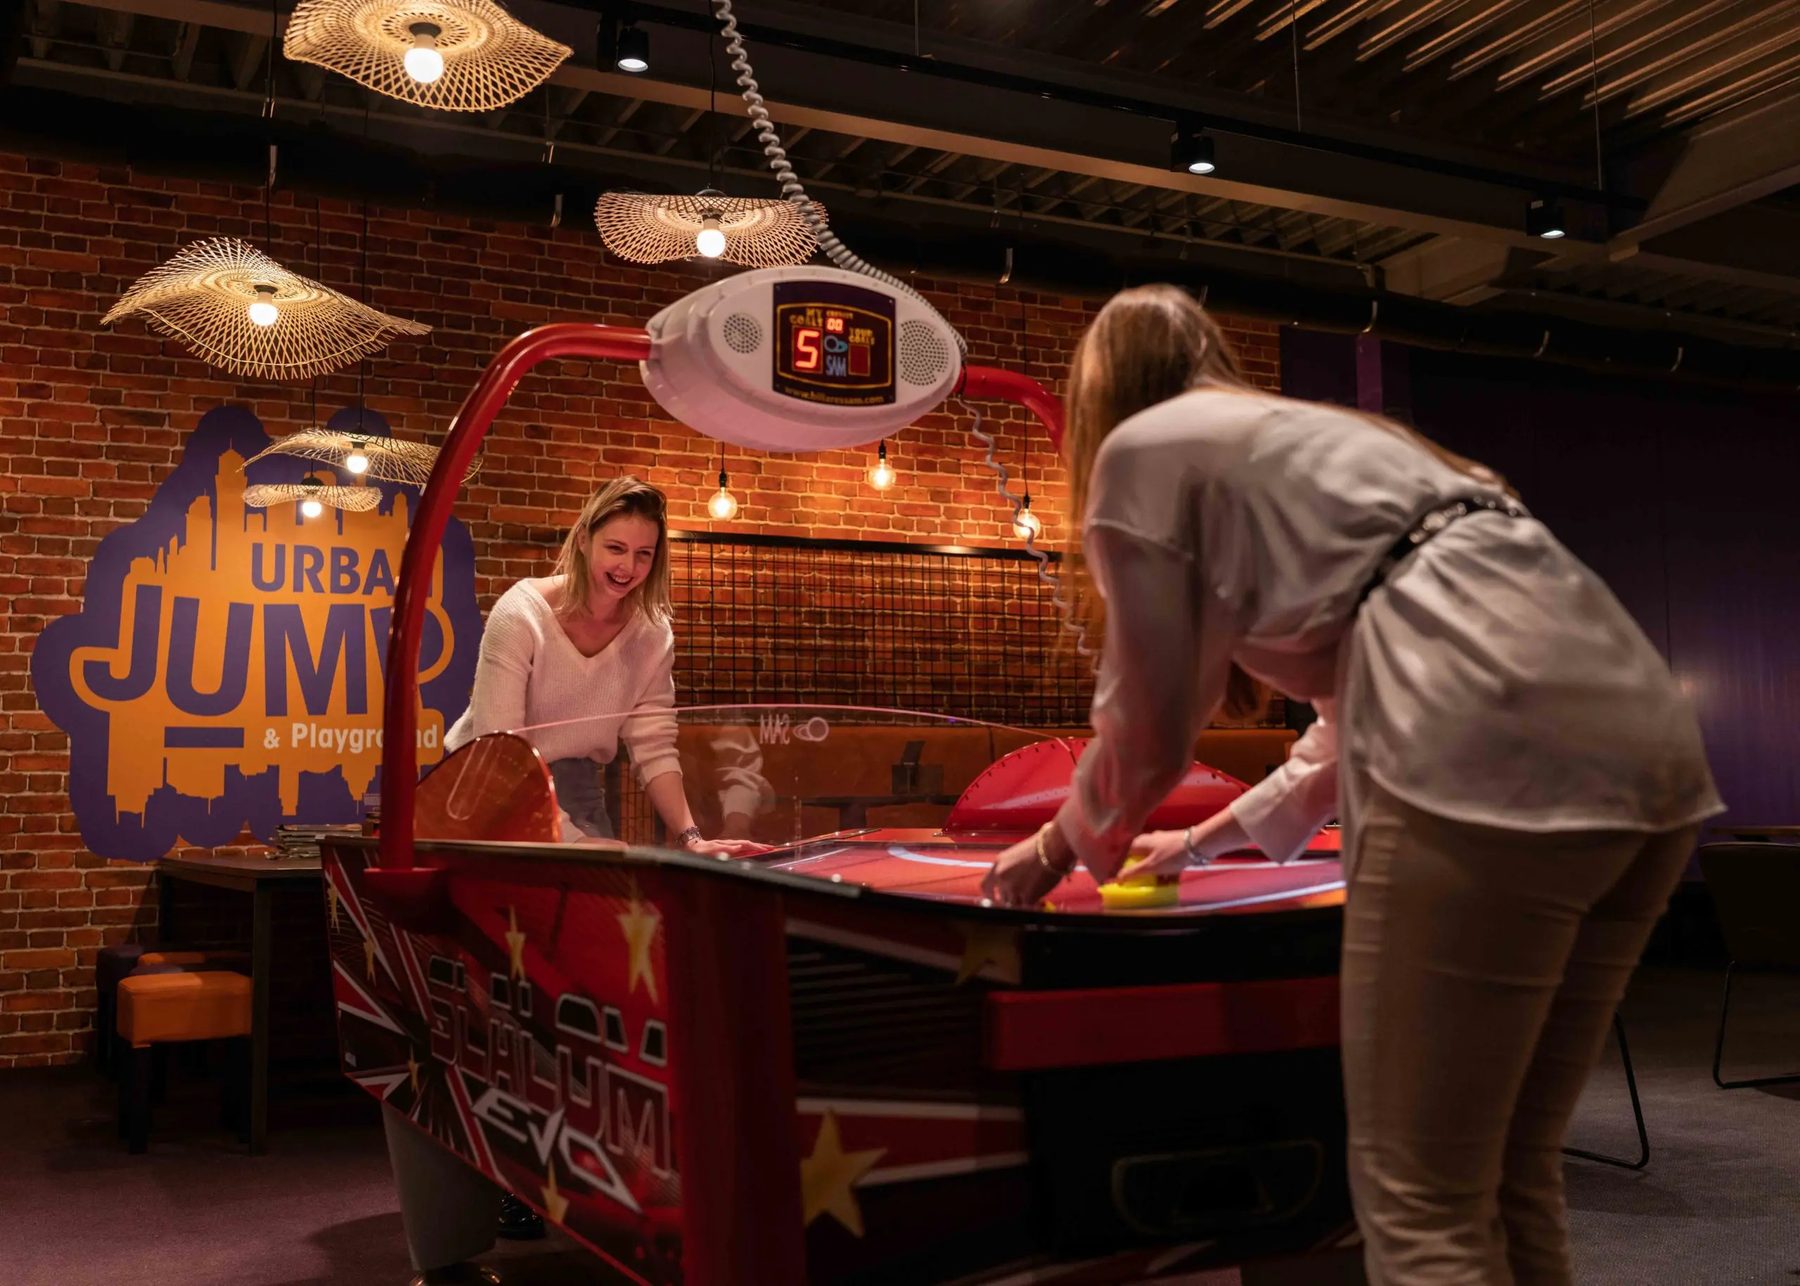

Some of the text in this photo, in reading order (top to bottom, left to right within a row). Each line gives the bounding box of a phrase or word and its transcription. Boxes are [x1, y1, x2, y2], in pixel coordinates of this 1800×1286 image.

[795, 329, 820, 369] 5
[826, 355, 847, 377] SAM
[251, 542, 432, 597] URBA
[263, 728, 280, 750] &
[471, 1087, 645, 1214] EVO
